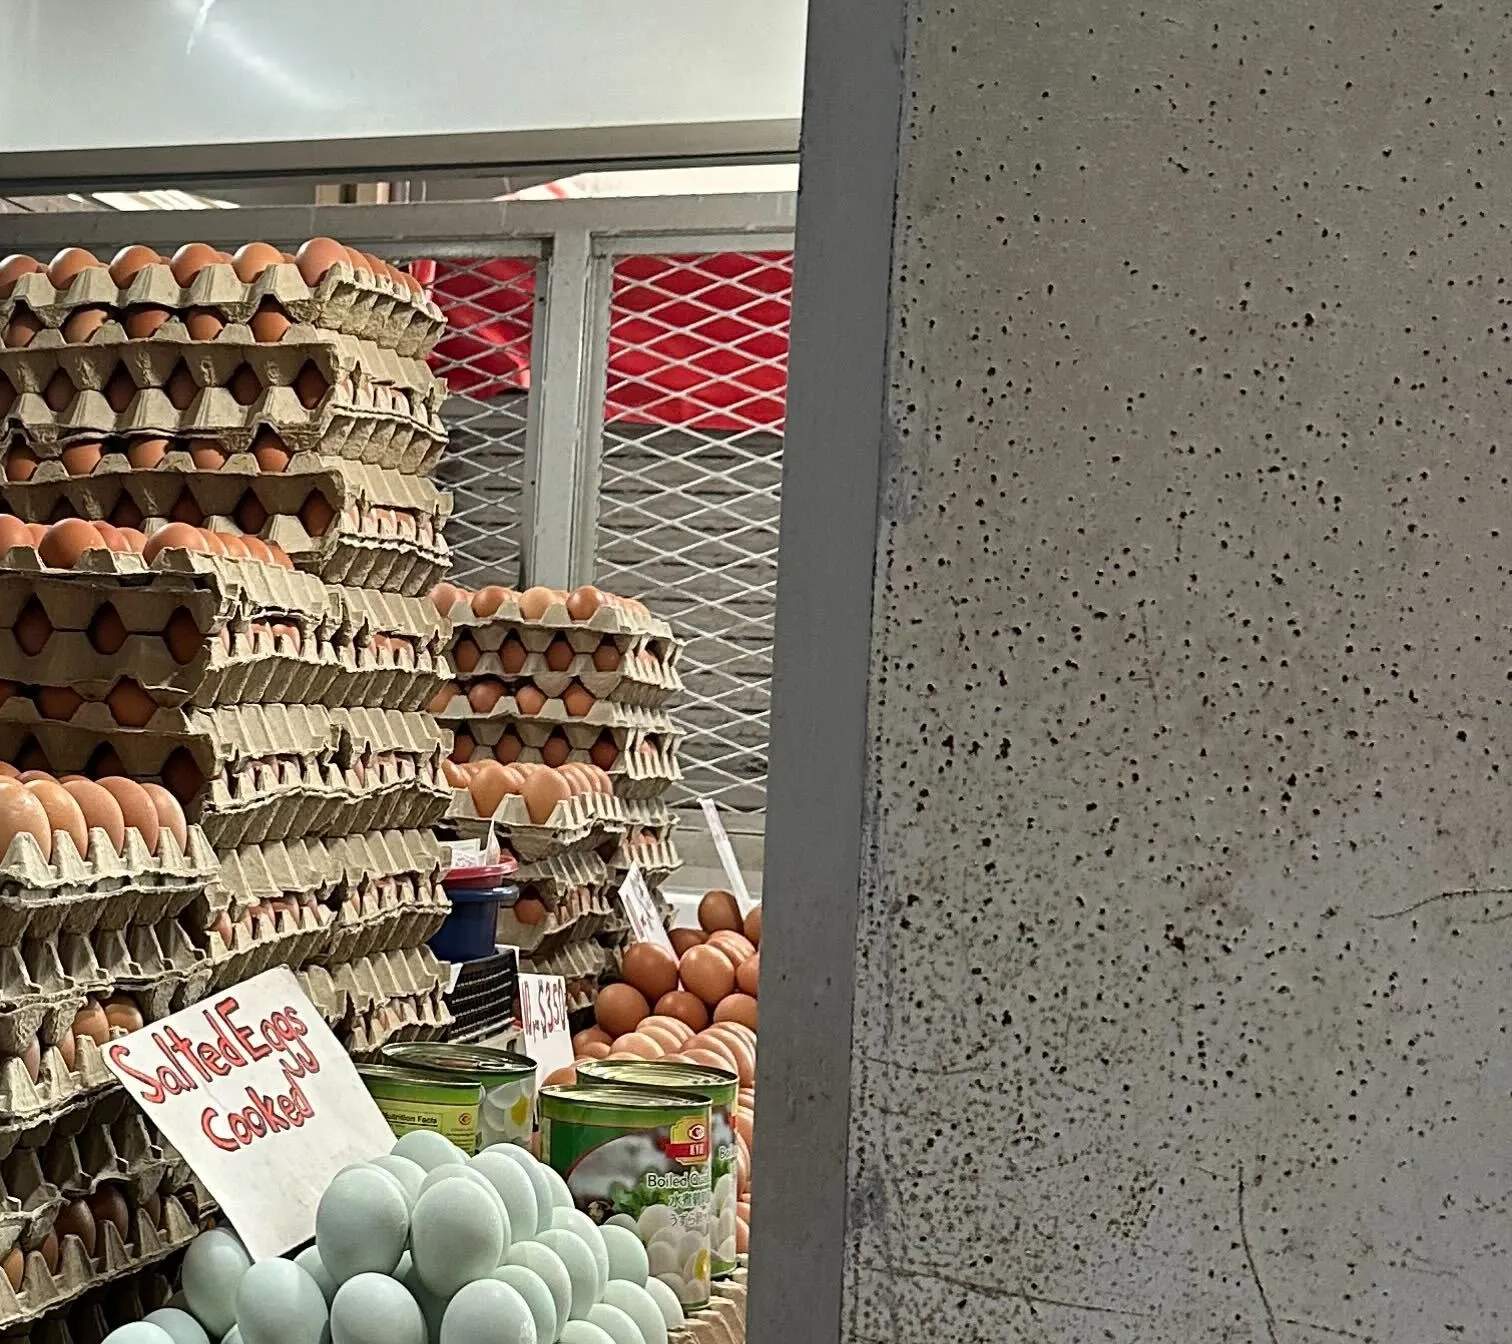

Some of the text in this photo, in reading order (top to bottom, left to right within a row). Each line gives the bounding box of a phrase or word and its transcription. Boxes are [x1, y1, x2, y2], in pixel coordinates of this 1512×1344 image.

[109, 997, 320, 1104] Salted Eggs
[201, 1069, 315, 1152] Cooked
[418, 1116, 437, 1124] Facts
[647, 1172, 688, 1188] Boiled
